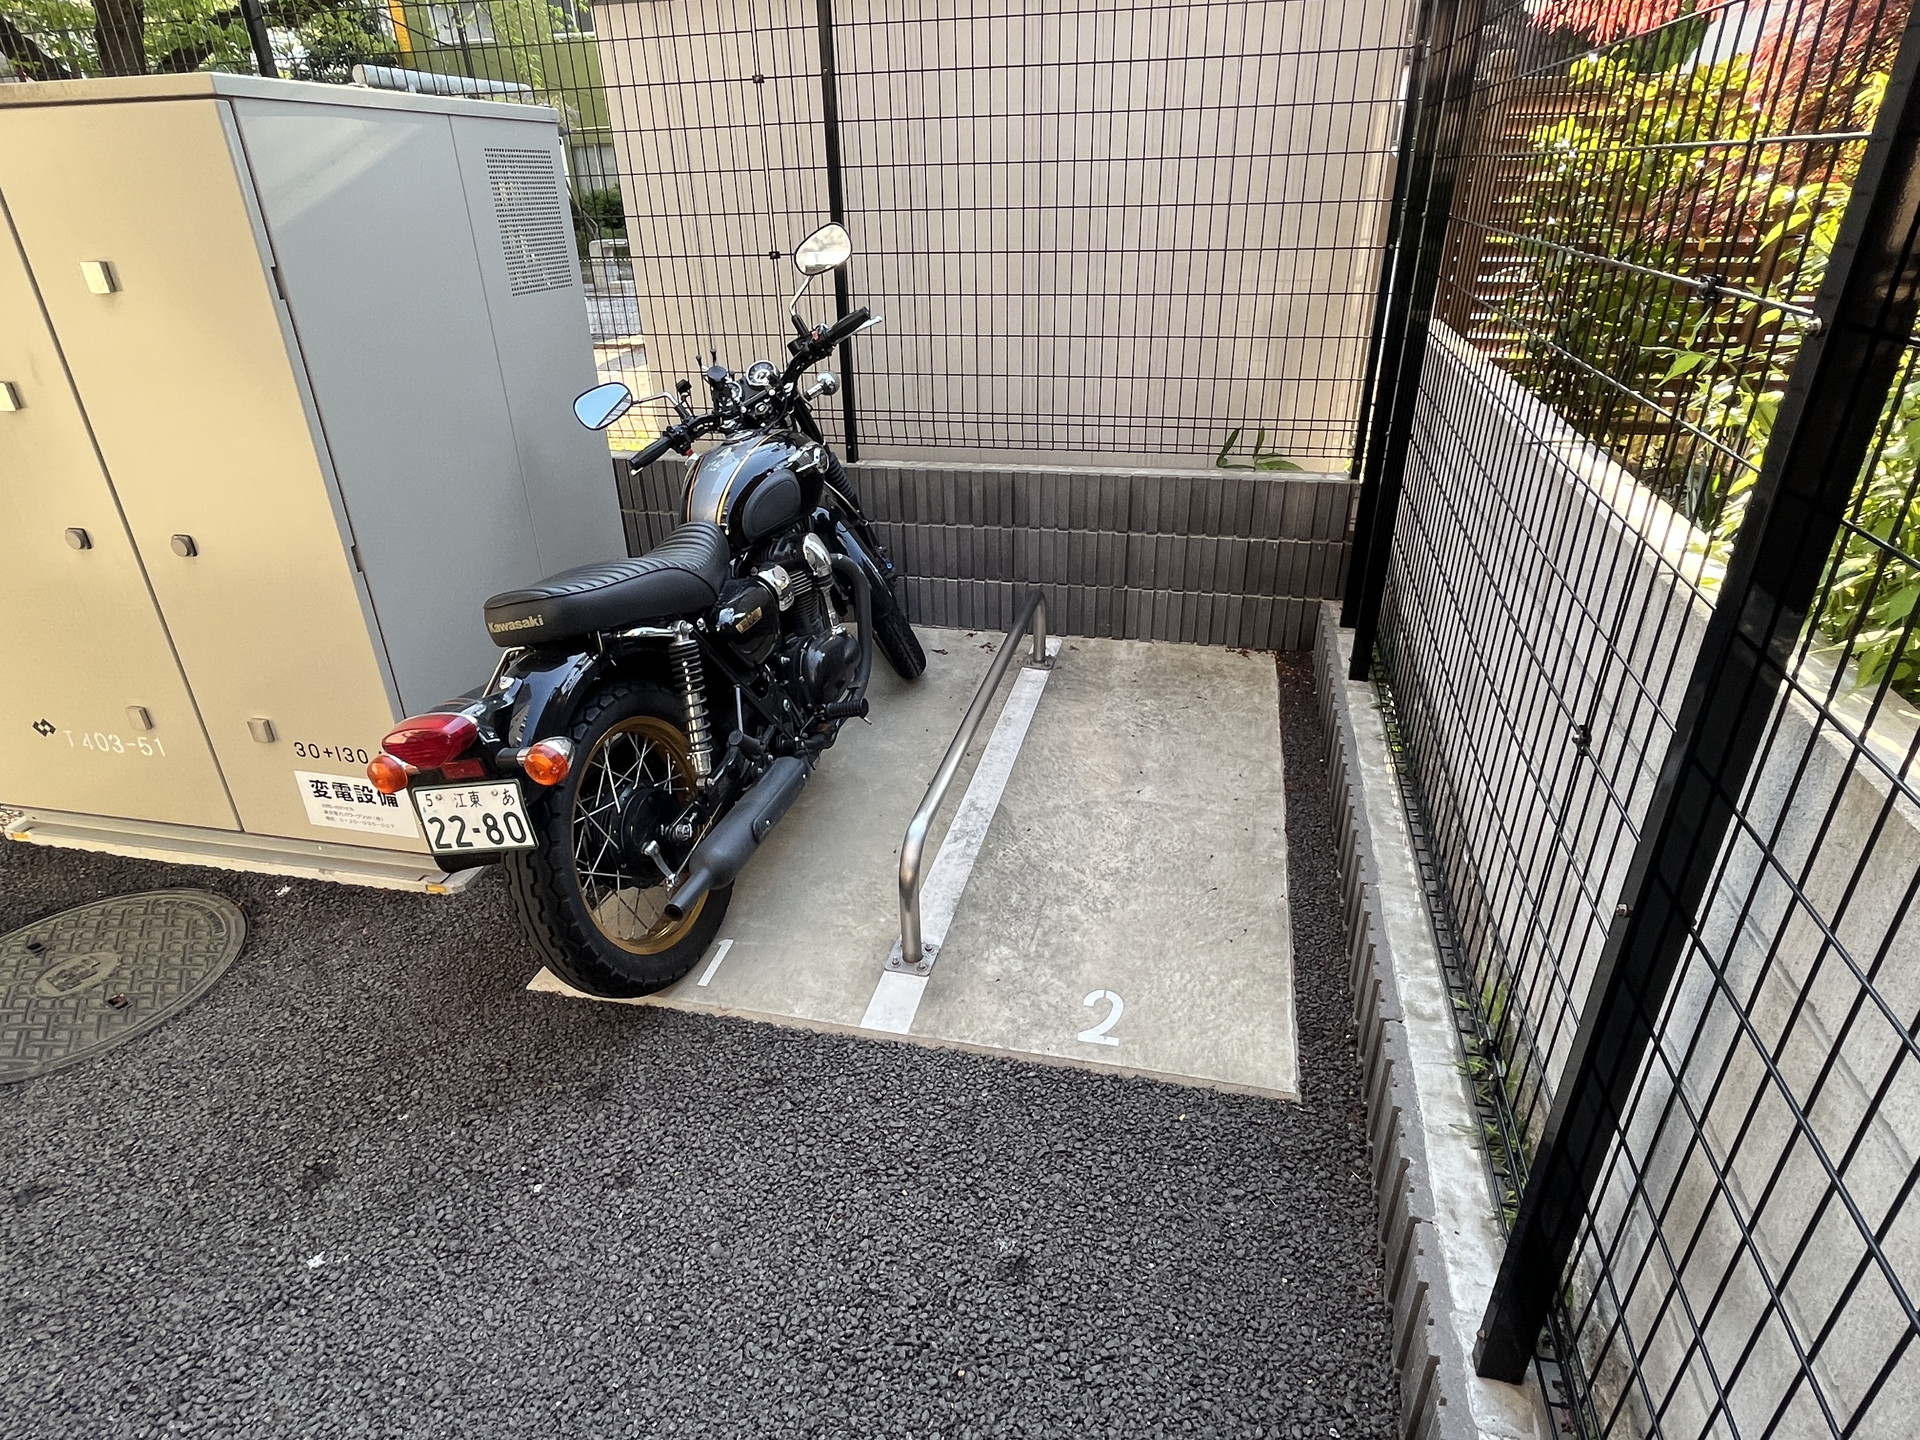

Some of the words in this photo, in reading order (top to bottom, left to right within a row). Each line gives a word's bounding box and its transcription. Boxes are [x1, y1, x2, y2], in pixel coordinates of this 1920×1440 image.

[487, 614, 544, 633] Kawasaki
[453, 791, 482, 808] 江東
[502, 788, 515, 806] あ
[427, 811, 527, 849] 22-80
[697, 938, 734, 987] 1
[1077, 989, 1125, 1047] 2
